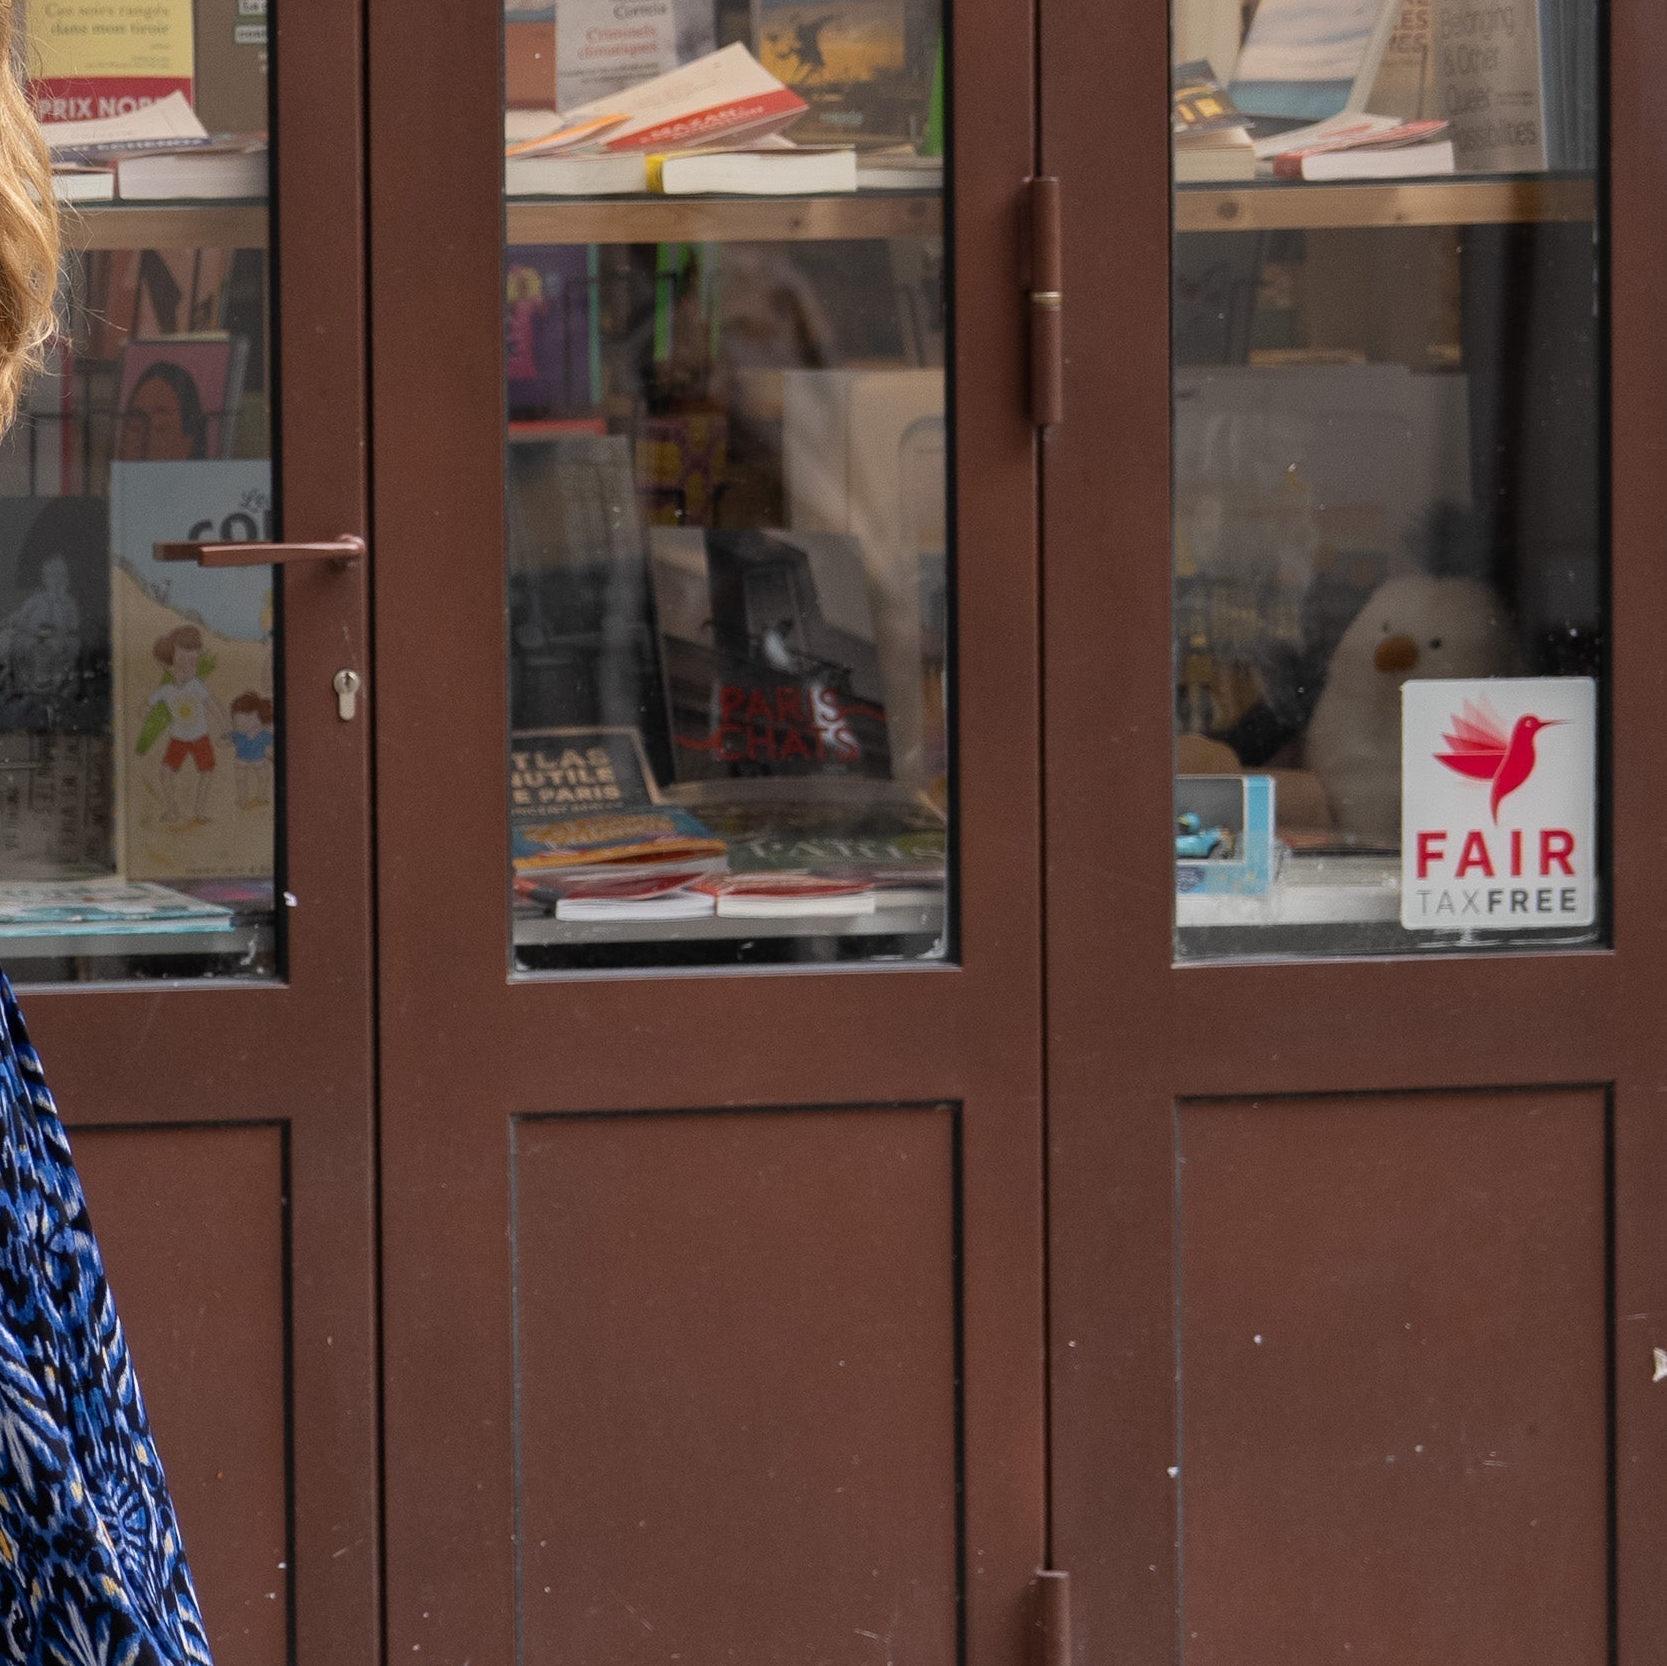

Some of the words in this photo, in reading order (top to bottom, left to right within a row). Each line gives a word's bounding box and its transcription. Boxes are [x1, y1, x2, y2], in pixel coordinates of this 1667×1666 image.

[38, 96, 93, 121] PRIX
[98, 92, 160, 118] NOB
[719, 685, 841, 723] PARIS
[717, 724, 861, 762] CHATS
[537, 784, 622, 803] PARIS
[1416, 828, 1576, 880] FAIR
[1416, 887, 1577, 915] TAXFREE
